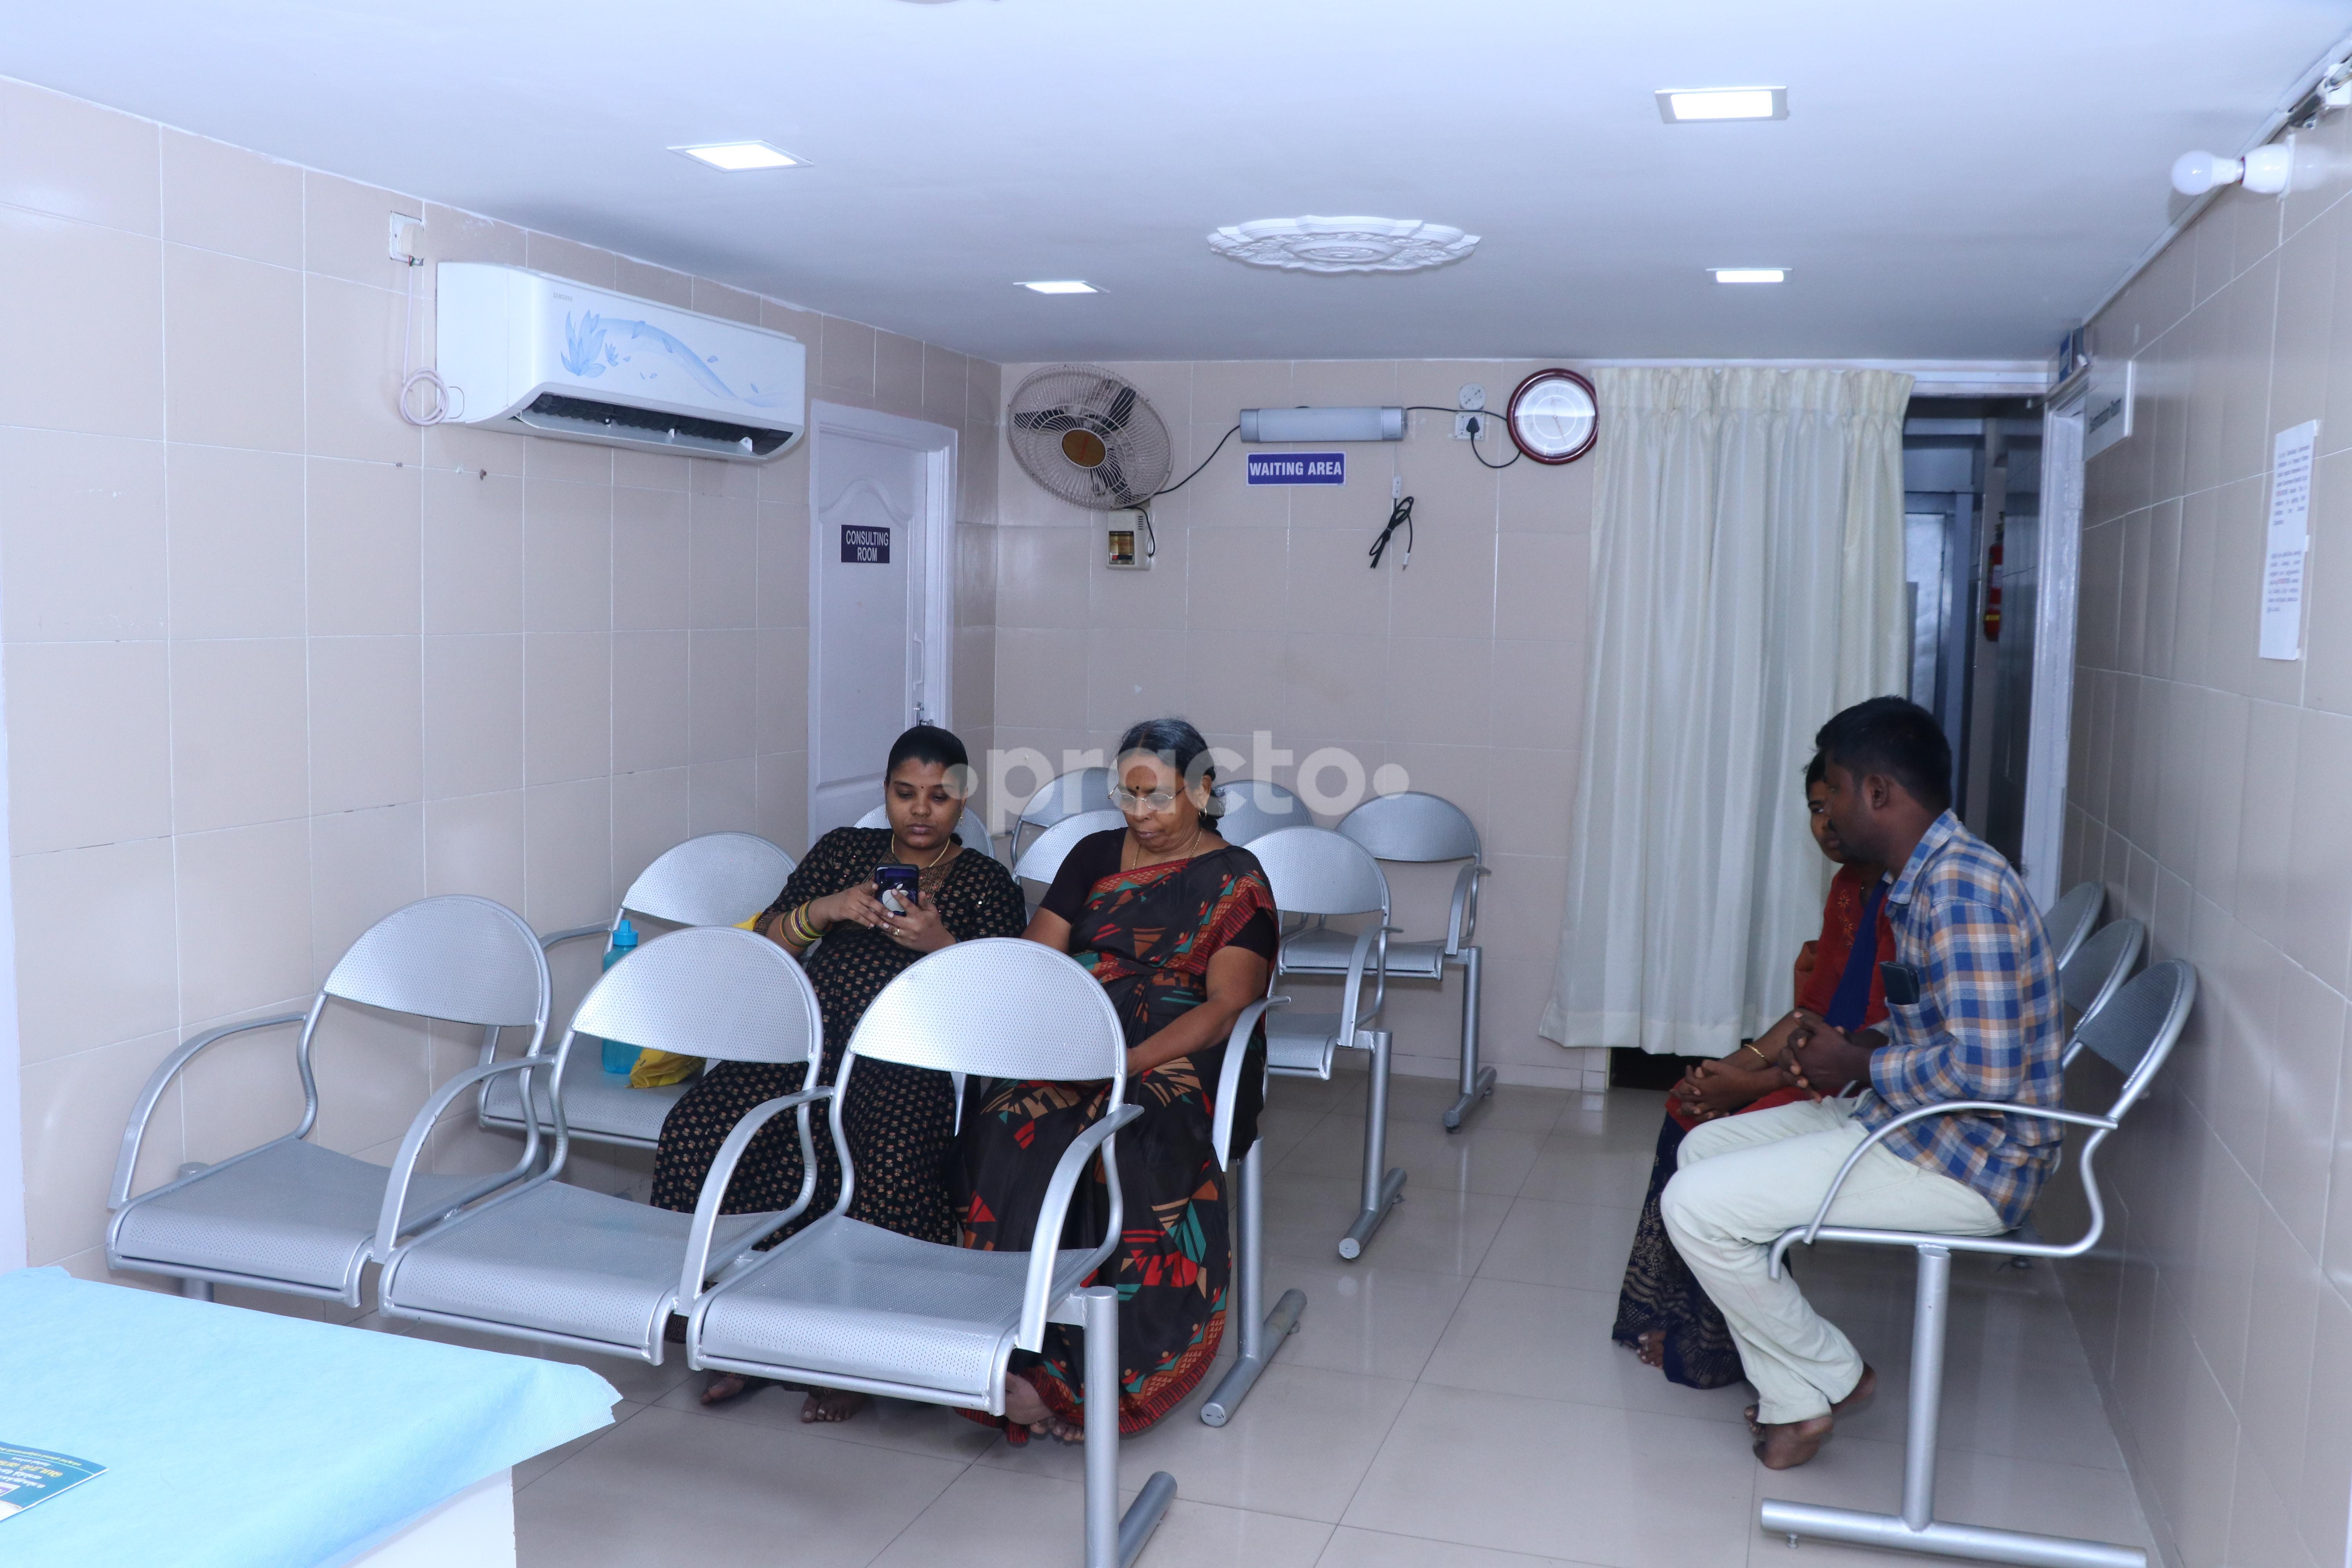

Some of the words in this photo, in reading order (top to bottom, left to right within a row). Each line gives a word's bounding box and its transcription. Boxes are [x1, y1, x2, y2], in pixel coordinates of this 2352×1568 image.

[553, 292, 573, 302] SAMSUNG
[1249, 462, 1303, 475] WAITING
[1308, 461, 1342, 475] AREA
[846, 530, 888, 546] CONSULTING
[857, 547, 877, 561] ROOM
